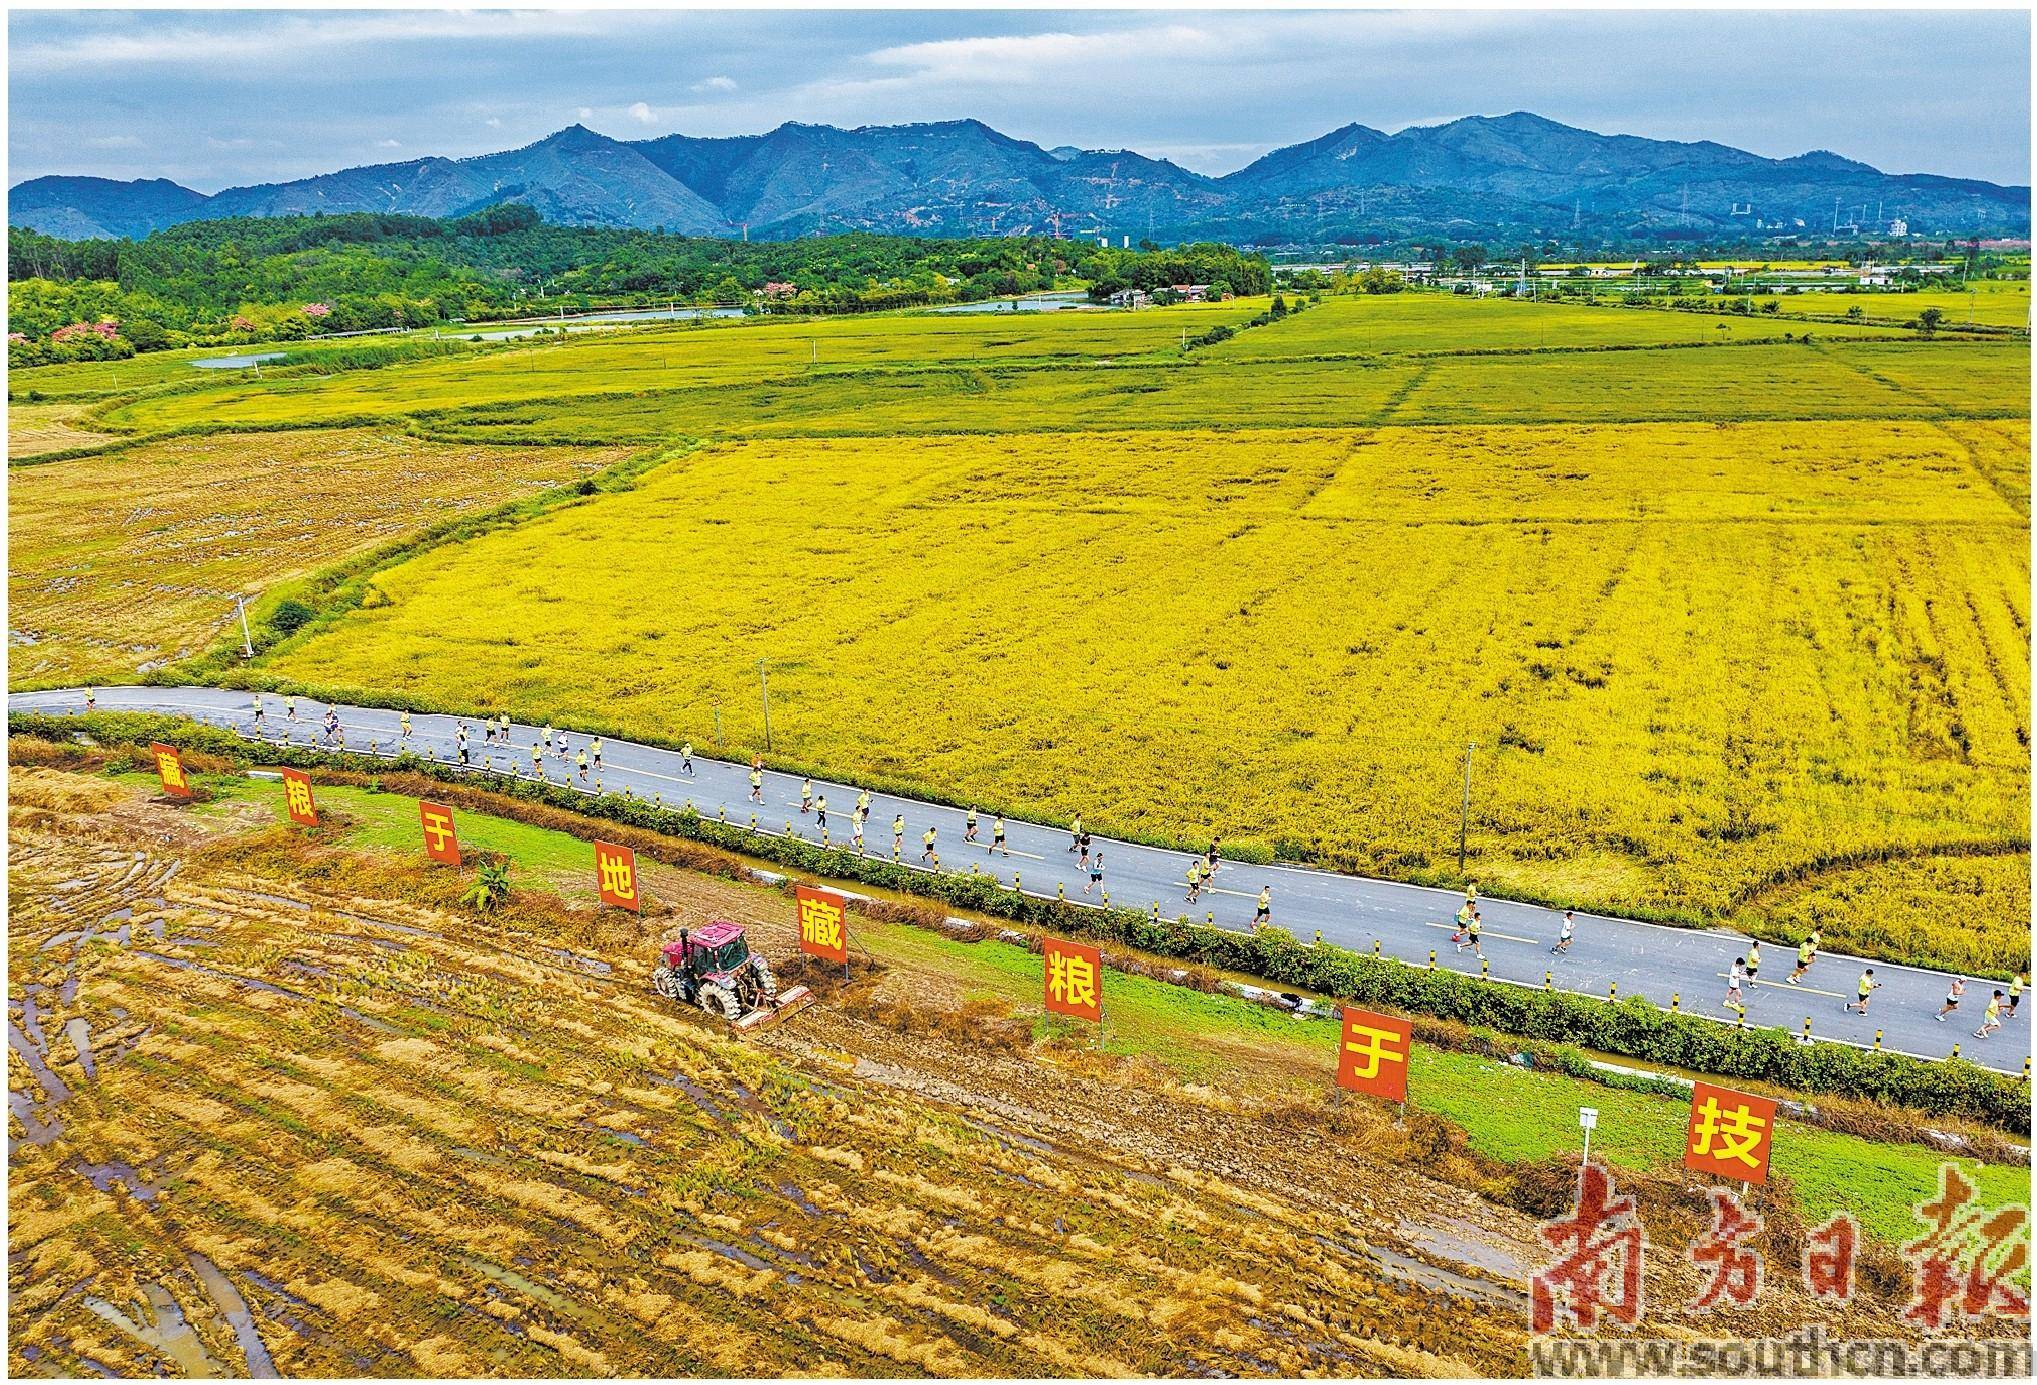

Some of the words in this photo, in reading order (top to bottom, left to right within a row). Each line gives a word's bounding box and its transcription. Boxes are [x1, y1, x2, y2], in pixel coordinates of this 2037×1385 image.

[156, 752, 185, 789] 藏
[285, 777, 314, 818] 粮
[425, 812, 455, 853] 于
[601, 852, 635, 901] 地
[801, 898, 843, 951] 藏
[1048, 951, 1097, 1009] 粮
[1346, 1023, 1404, 1079] 于
[1692, 1096, 1766, 1169] 技
